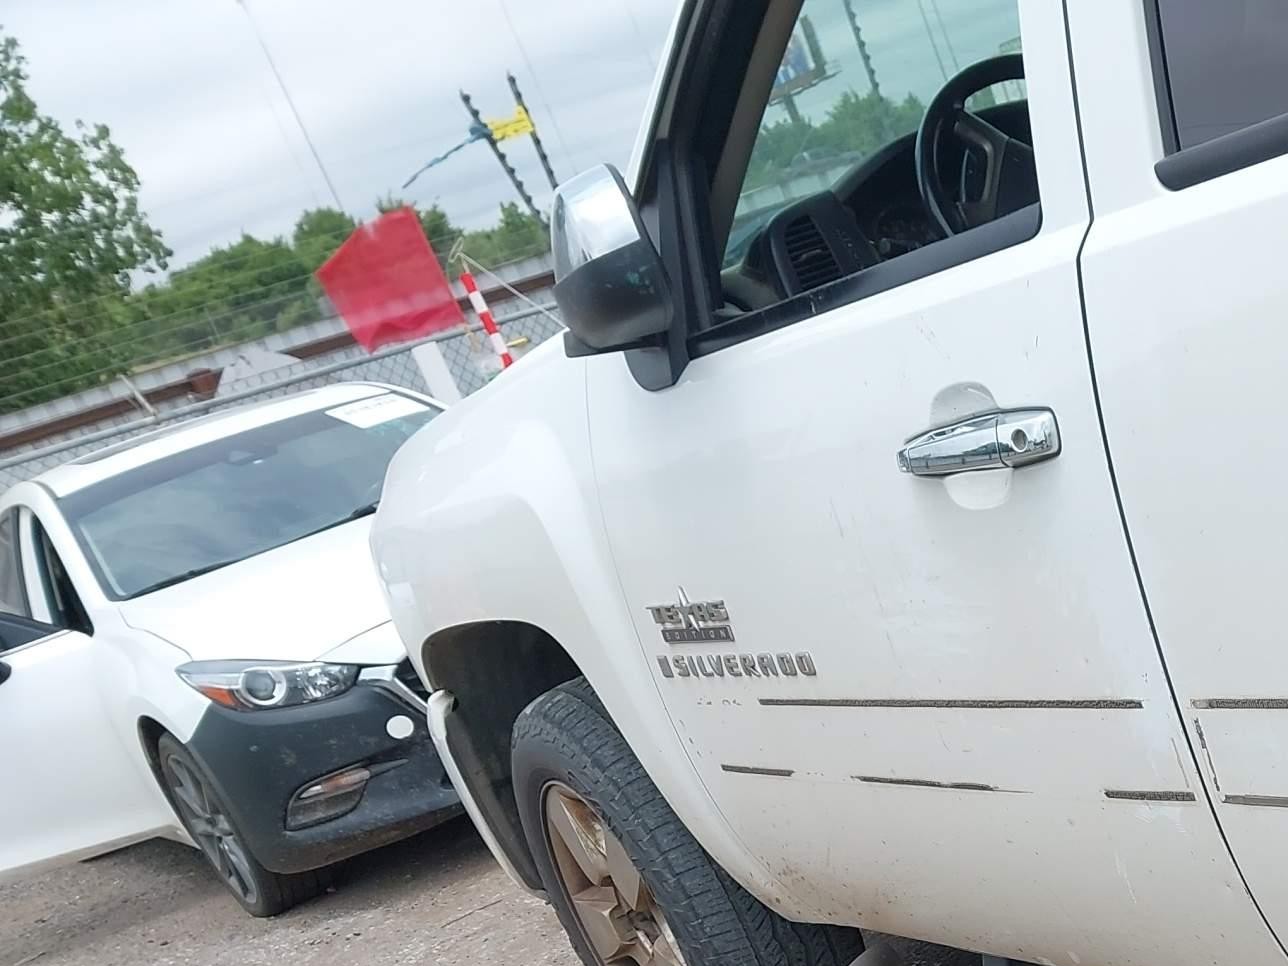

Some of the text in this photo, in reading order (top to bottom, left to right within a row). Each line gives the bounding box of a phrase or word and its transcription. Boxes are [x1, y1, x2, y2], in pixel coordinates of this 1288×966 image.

[647, 599, 730, 627] TEXAS
[664, 629, 728, 641] EDITION
[672, 653, 817, 678] SILVERADO
